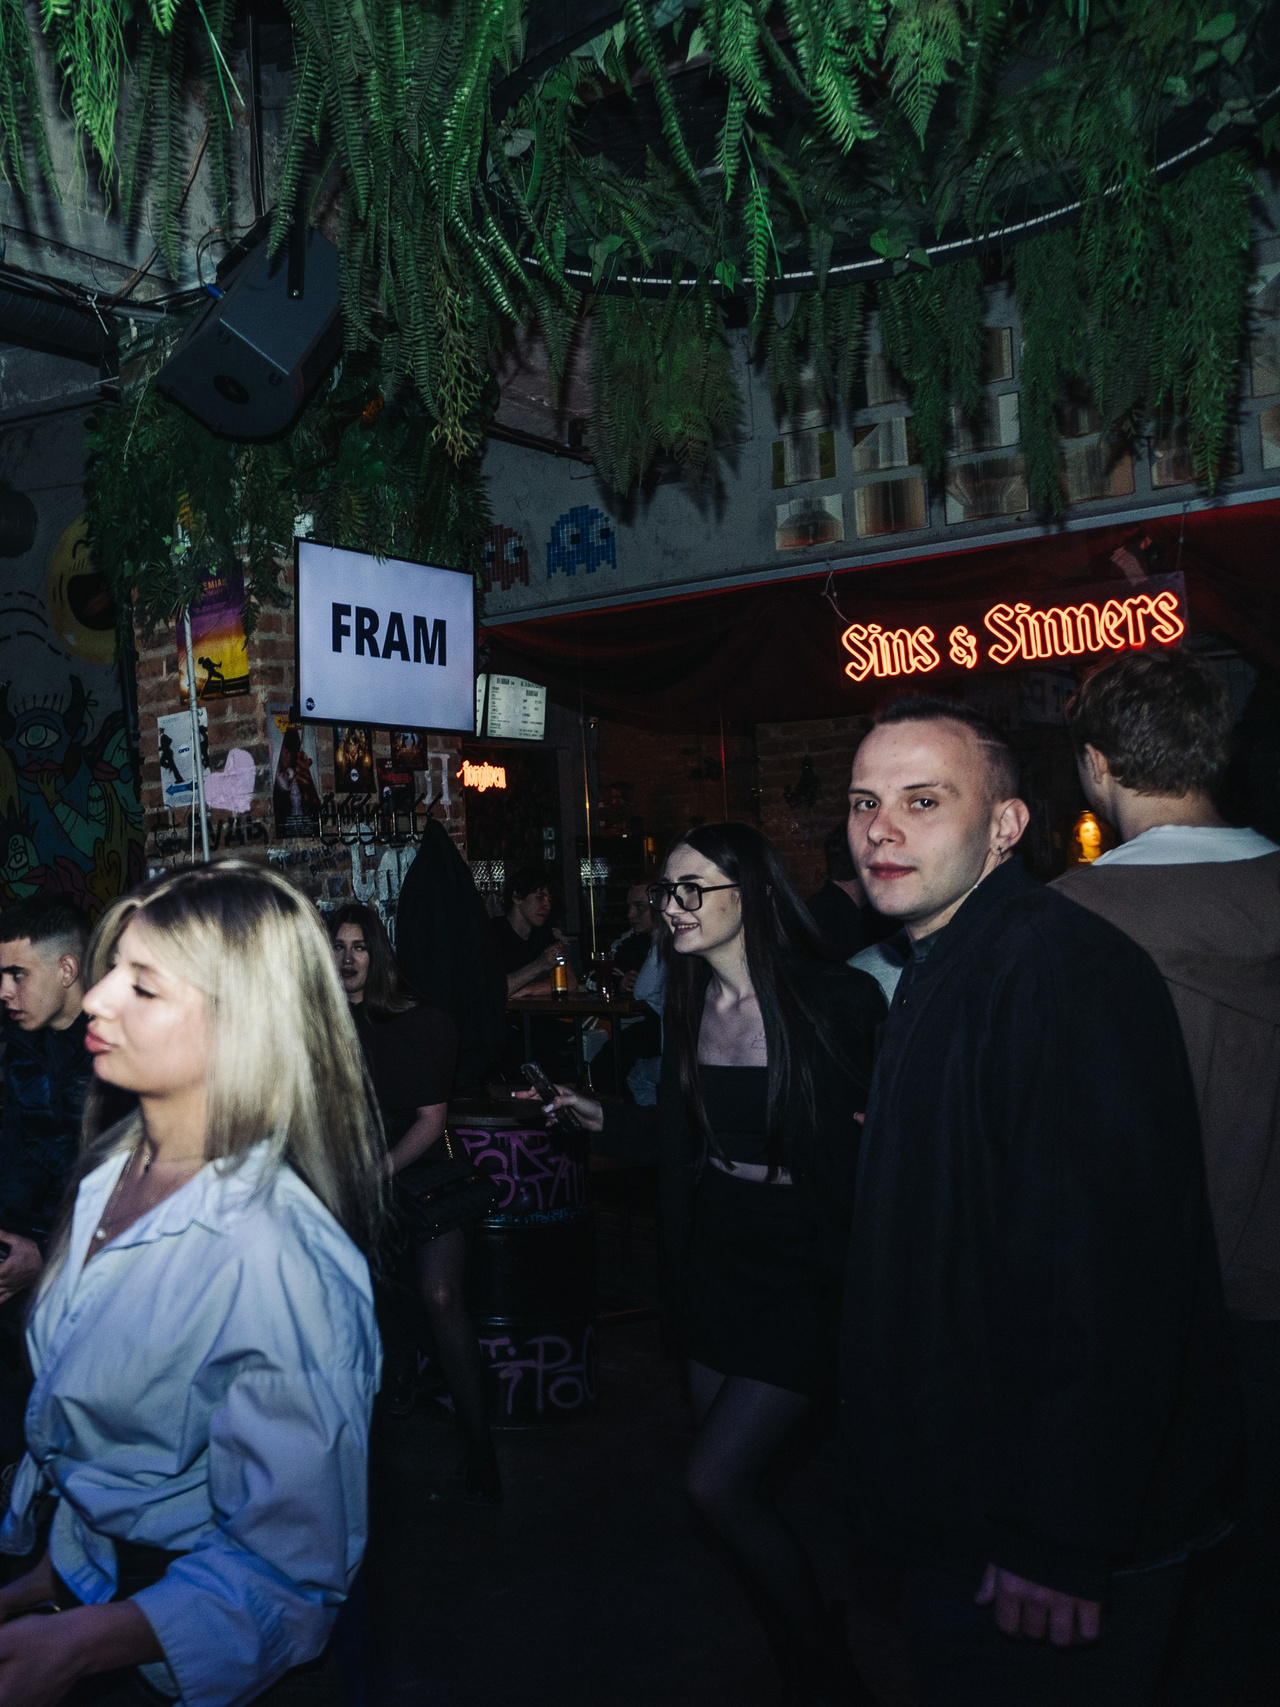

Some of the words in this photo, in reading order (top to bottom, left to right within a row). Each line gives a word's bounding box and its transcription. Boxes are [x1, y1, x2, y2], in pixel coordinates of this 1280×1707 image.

[331, 601, 448, 667] FRAM
[841, 622, 940, 682] Sins
[948, 625, 977, 669] &
[983, 591, 1185, 665] Sinners
